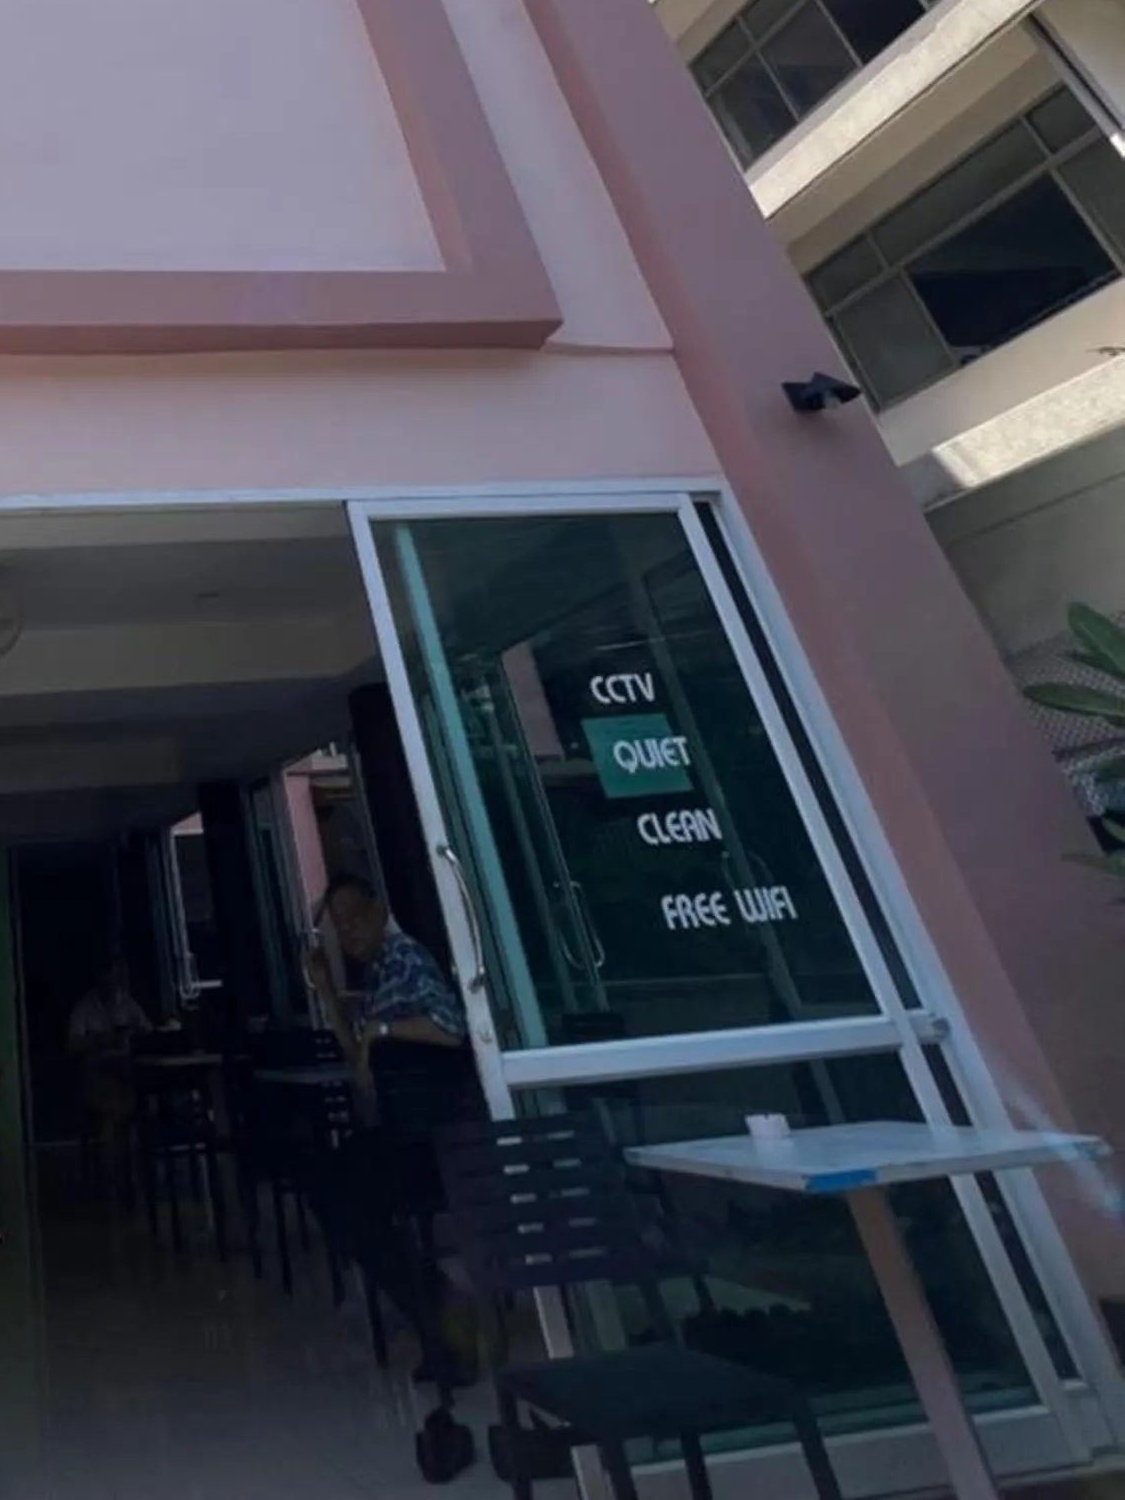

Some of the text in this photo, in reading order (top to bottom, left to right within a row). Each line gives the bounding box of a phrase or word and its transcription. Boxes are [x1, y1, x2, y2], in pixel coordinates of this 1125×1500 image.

[590, 673, 656, 704] CCTV
[612, 736, 692, 774] QUIET
[637, 808, 723, 846] CLEAN
[661, 886, 798, 930] FREE WIFI
